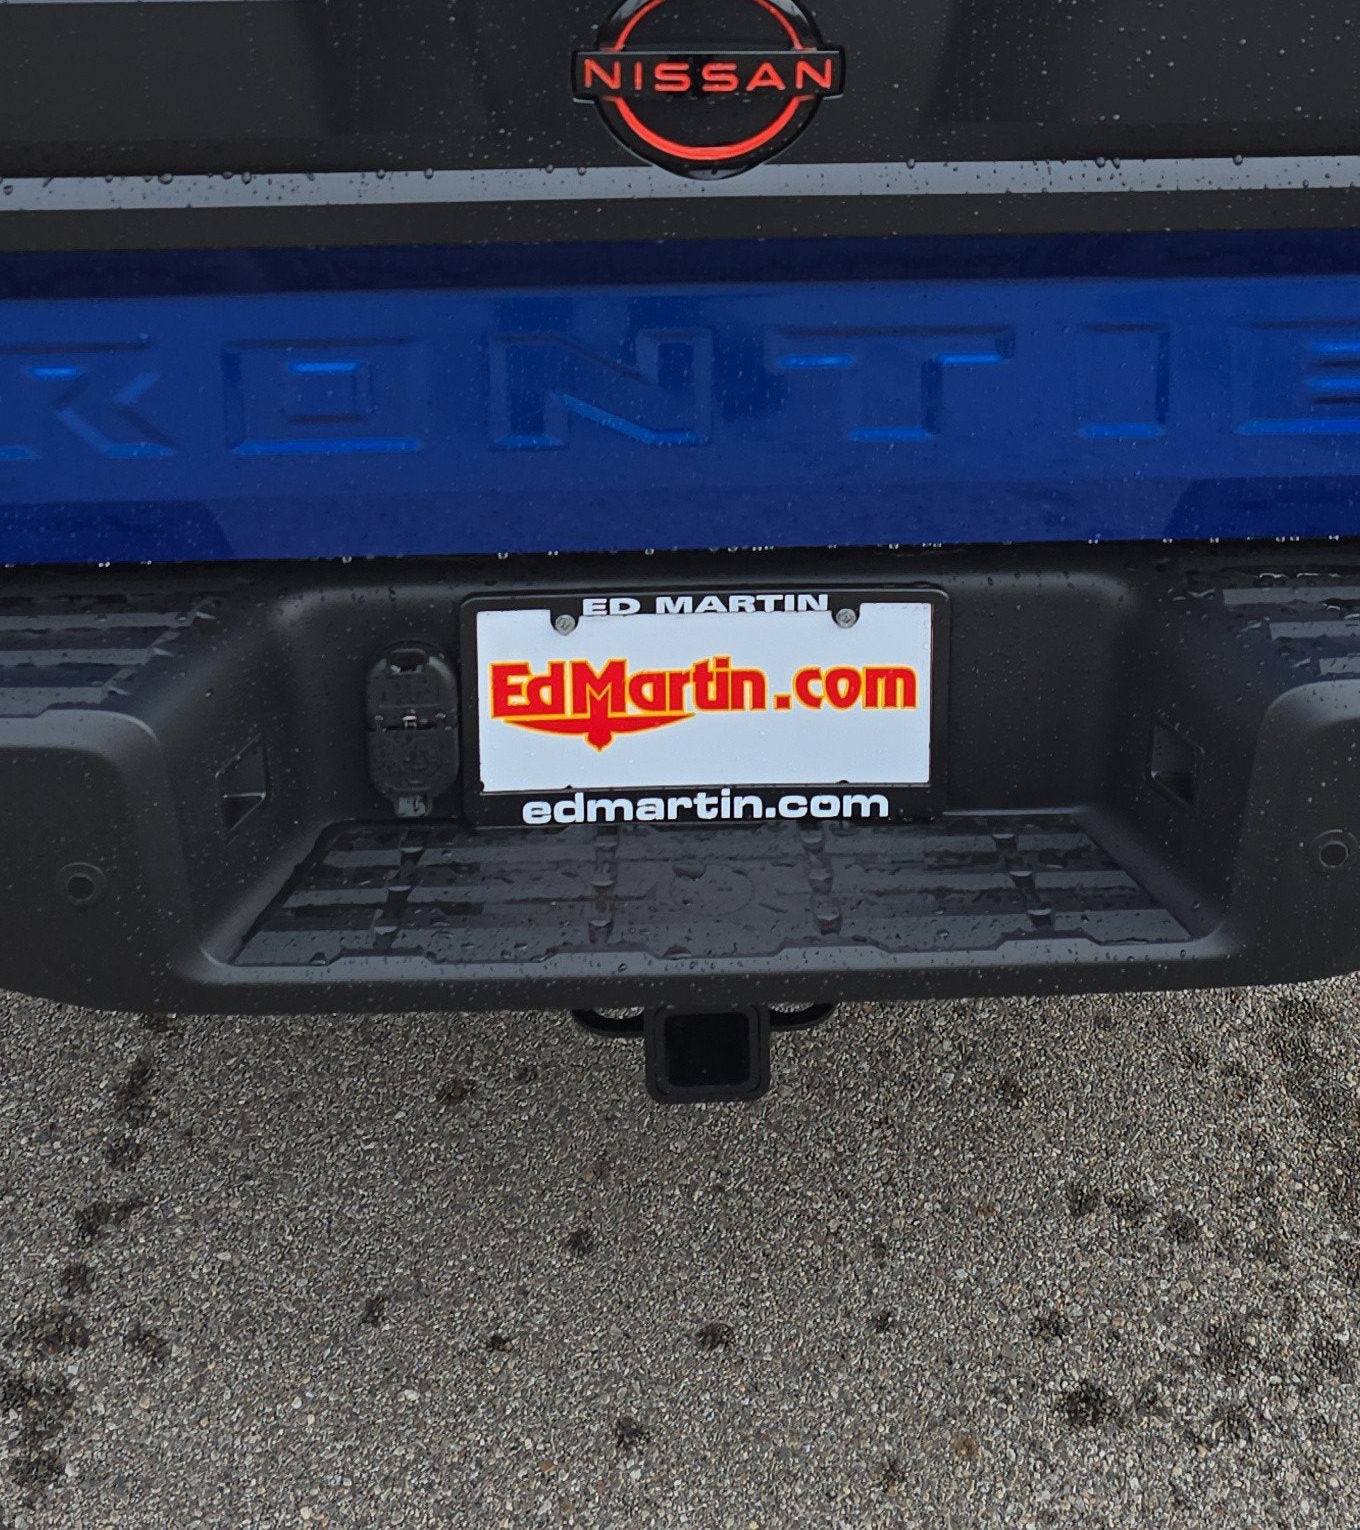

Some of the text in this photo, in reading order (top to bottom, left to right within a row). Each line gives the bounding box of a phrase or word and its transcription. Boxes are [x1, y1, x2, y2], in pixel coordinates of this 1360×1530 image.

[583, 58, 832, 93] NISSAN
[582, 593, 829, 616] ED MARTIN
[490, 654, 918, 726] EdMartin.com
[522, 788, 889, 826] edmartin.com
